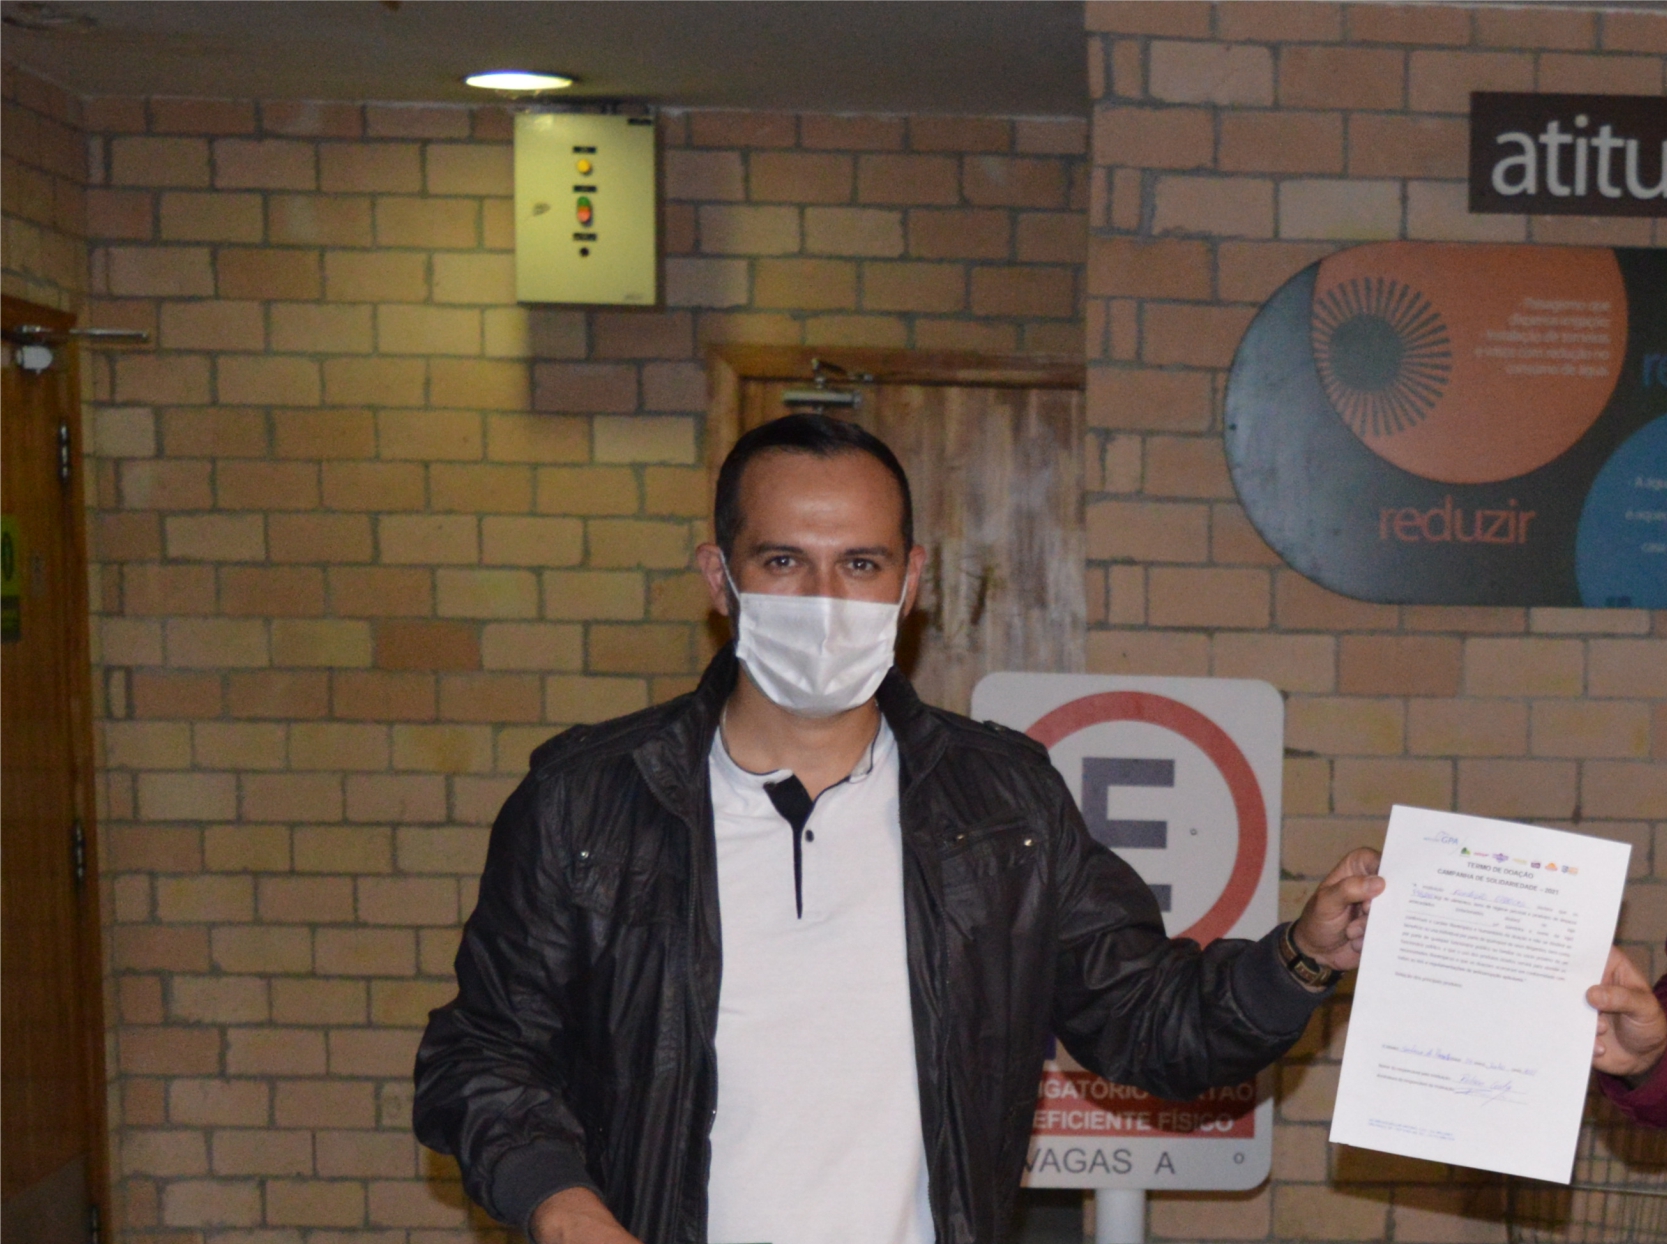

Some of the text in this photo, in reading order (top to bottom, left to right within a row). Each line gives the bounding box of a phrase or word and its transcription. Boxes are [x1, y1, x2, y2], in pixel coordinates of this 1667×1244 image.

[1379, 495, 1535, 544] reduzir
[1082, 757, 1175, 913] E
[1033, 1110, 1150, 1130] EFICIENTE
[1155, 1151, 1176, 1174] A
